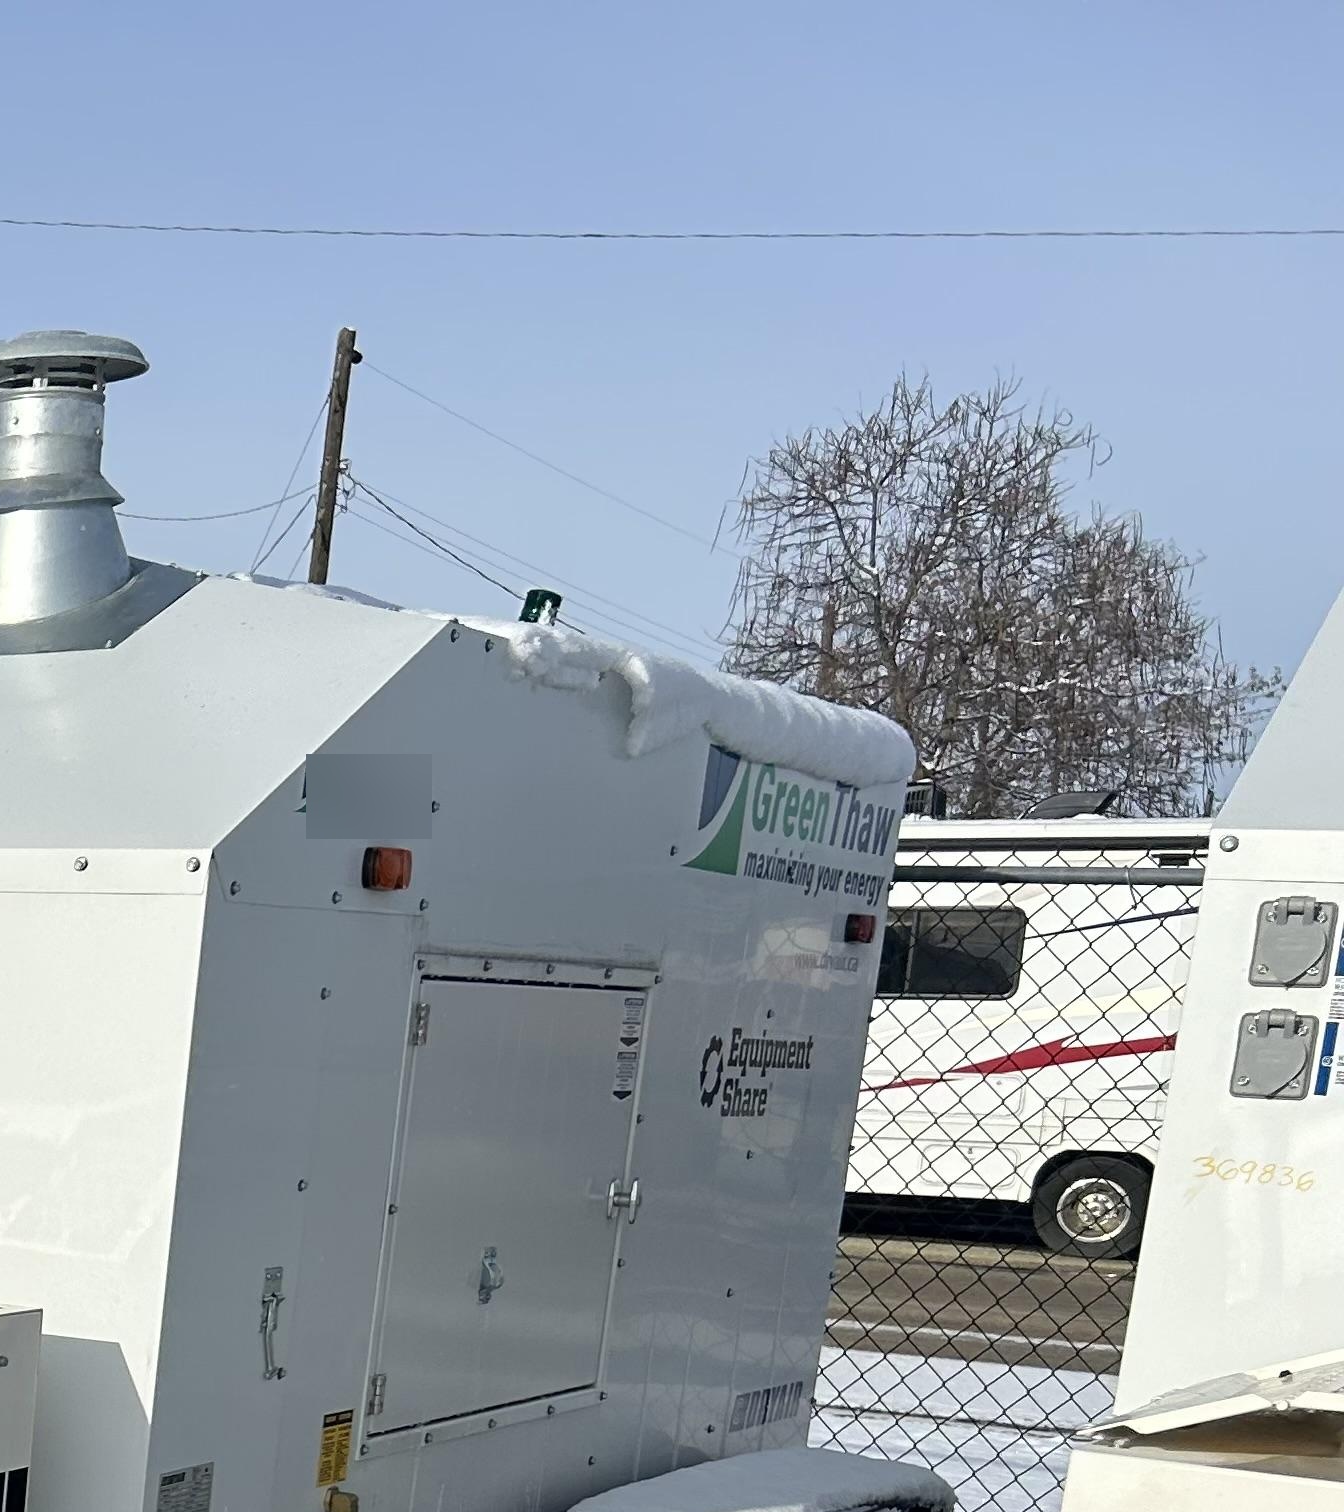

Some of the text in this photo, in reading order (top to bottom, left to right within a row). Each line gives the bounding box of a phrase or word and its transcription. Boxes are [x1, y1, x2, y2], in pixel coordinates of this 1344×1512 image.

[743, 847, 886, 908] maximizing your energy
[727, 1027, 814, 1078] Equipment
[720, 1078, 768, 1117] Share
[1192, 1156, 1316, 1193] 369836
